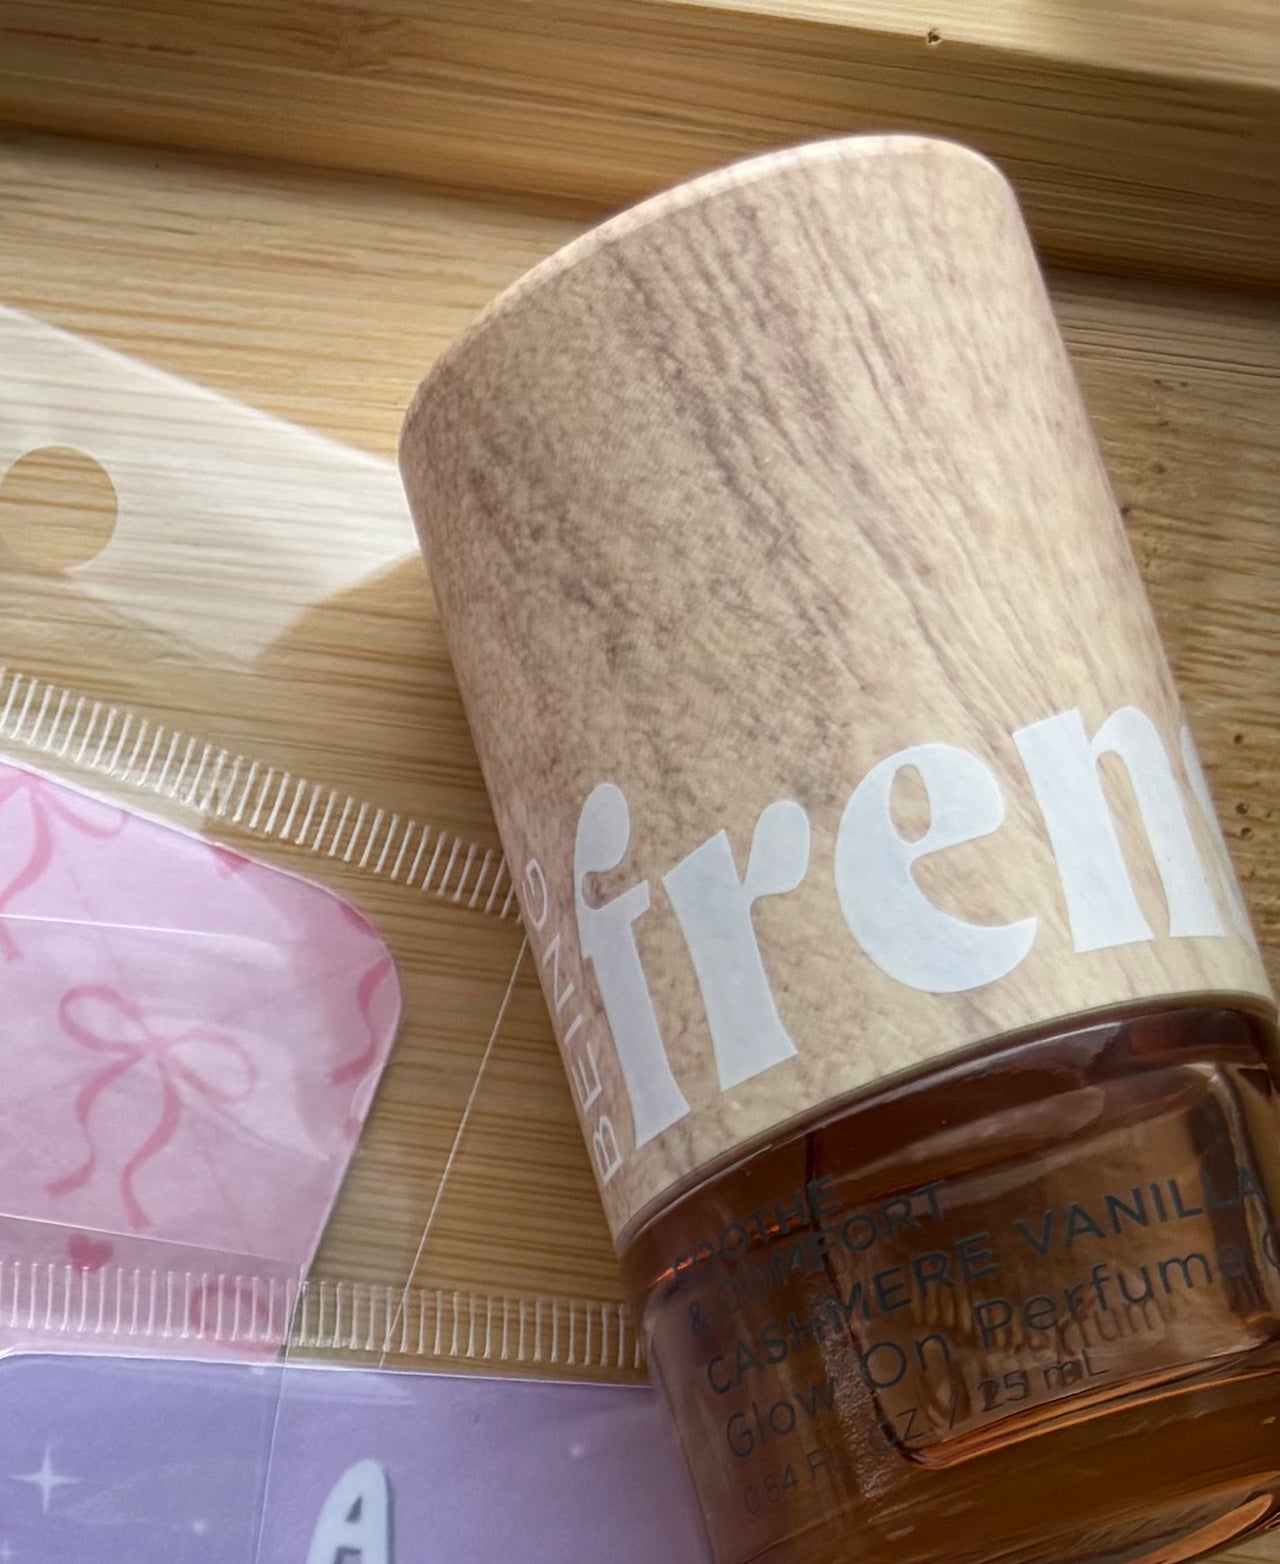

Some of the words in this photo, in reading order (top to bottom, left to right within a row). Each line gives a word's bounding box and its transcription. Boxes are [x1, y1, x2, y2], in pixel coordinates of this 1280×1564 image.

[523, 858, 623, 1186] BEING
[573, 705, 1259, 1149] fren
[689, 1300, 708, 1336] &
[717, 1180, 947, 1315] COMFORT
[706, 1232, 1000, 1396] CASHMERE
[1014, 1165, 1267, 1257] VANILLA
[726, 1377, 836, 1460] Glow
[860, 1332, 951, 1391] On
[973, 1244, 1247, 1350] Perfume
